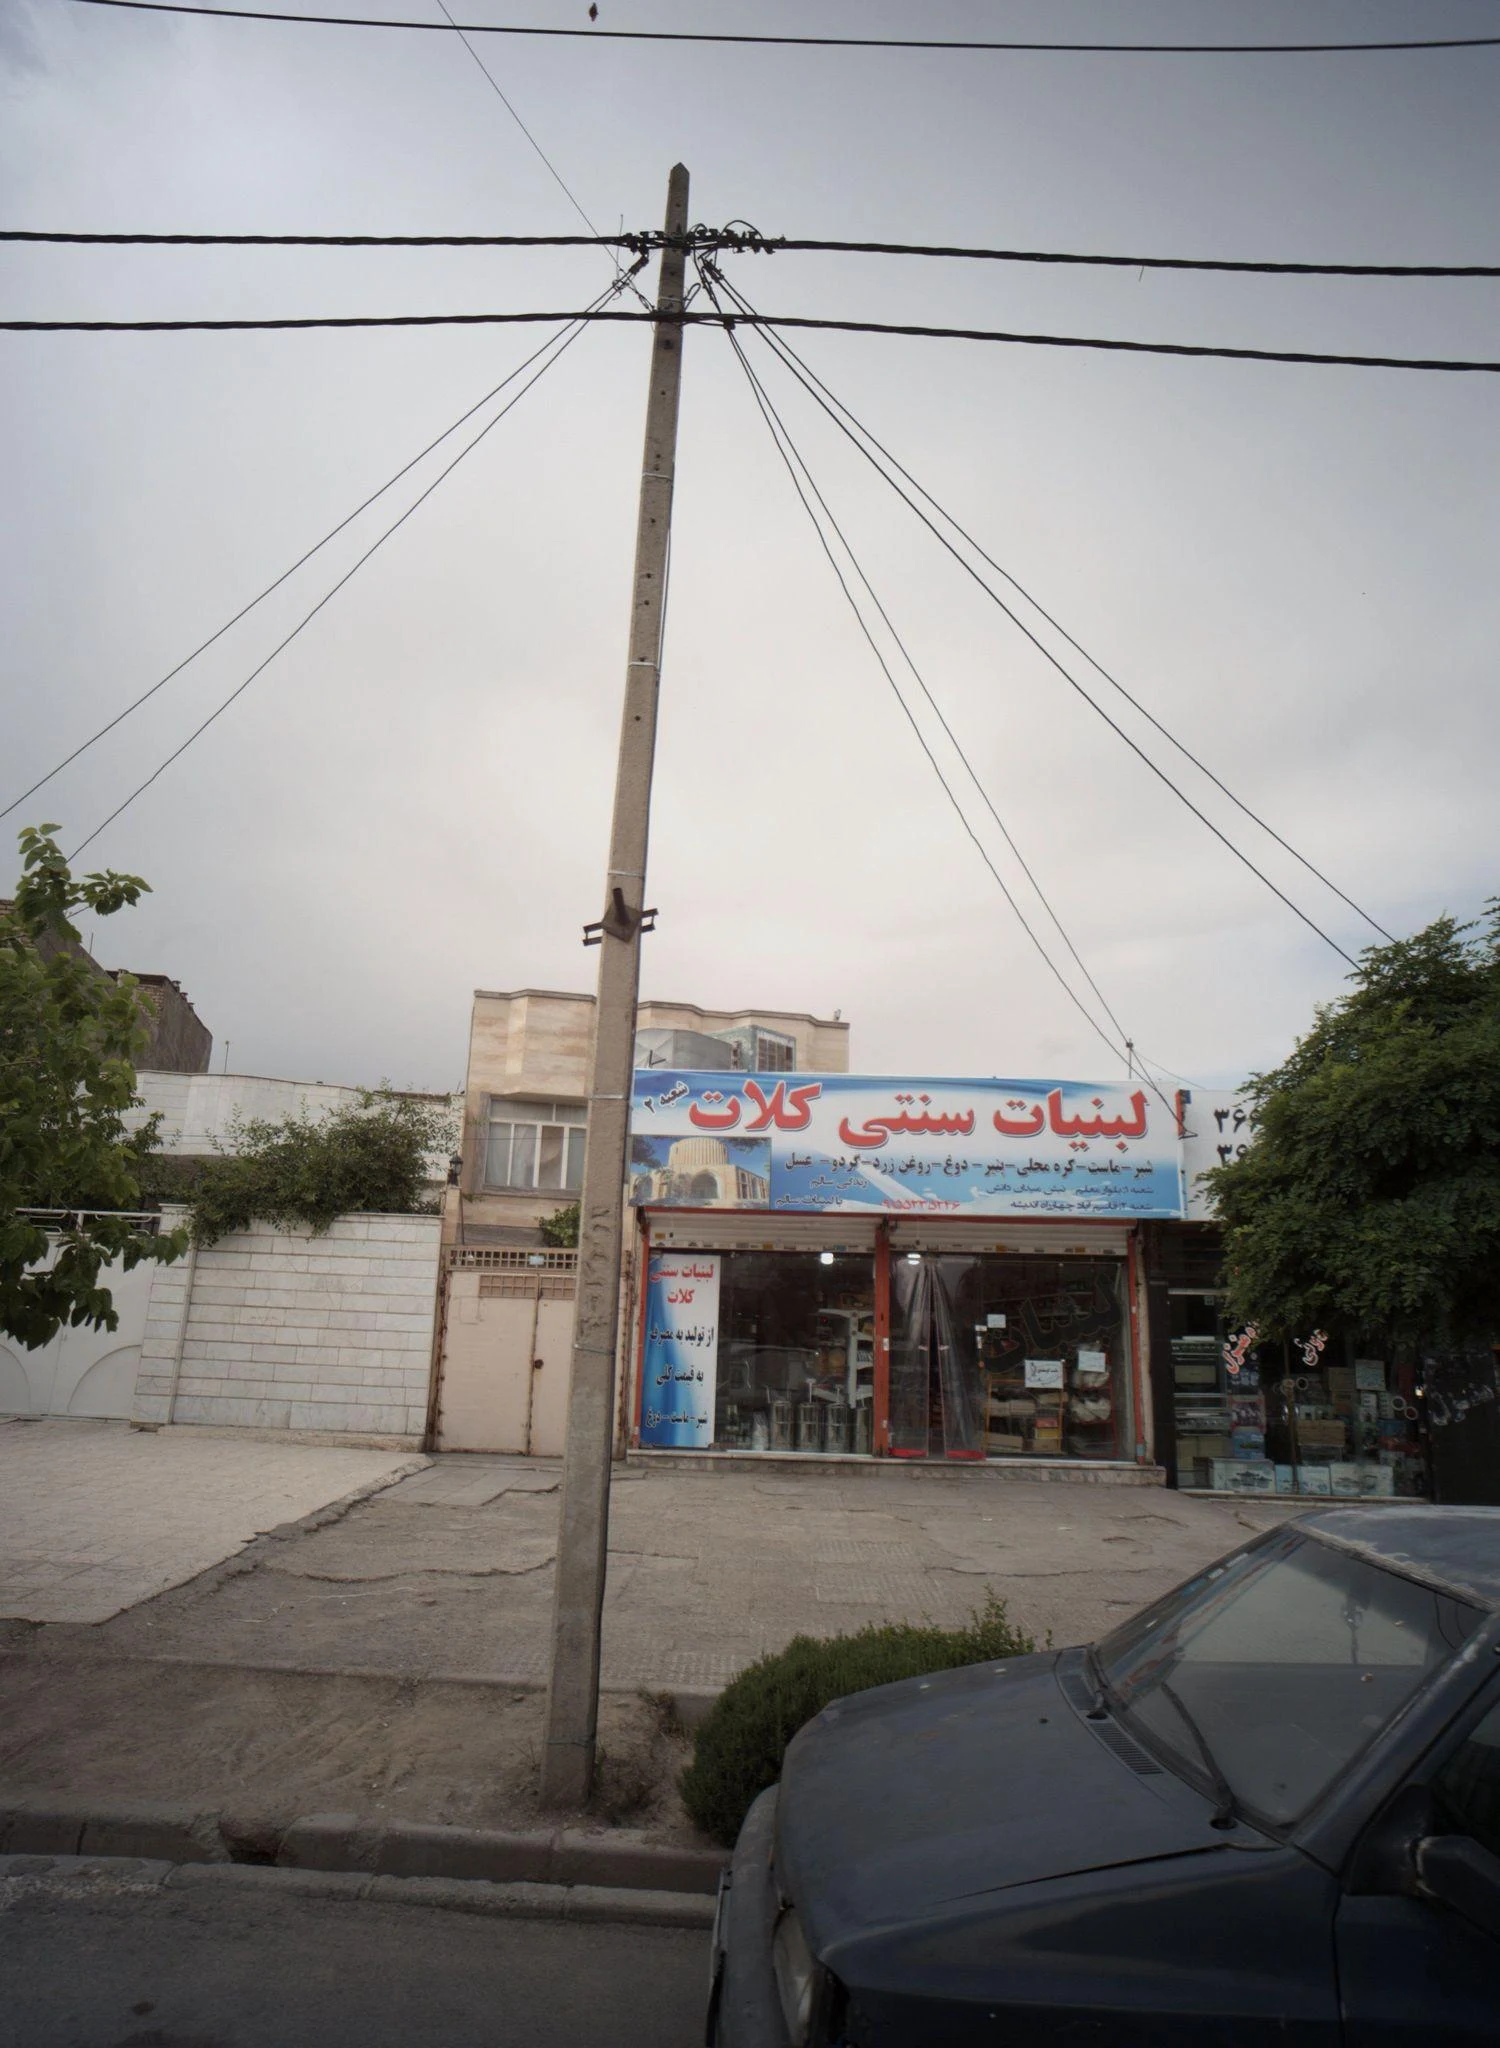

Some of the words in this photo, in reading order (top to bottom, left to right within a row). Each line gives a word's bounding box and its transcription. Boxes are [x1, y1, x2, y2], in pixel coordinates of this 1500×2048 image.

[658, 1080, 690, 1107] شعبه
[643, 1096, 656, 1115] ۲
[688, 1079, 823, 1132] کلات
[838, 1093, 976, 1150] سنتی
[993, 1087, 1149, 1152] لبنیات
[785, 1152, 812, 1170] عسل
[831, 1154, 861, 1173] گردو
[873, 1157, 895, 1174] زرد
[898, 1155, 931, 1175] روغن
[943, 1154, 968, 1176] دوغ
[1017, 1158, 1050, 1176] محلی
[1054, 1159, 1075, 1178] کره
[1088, 1159, 1120, 1174] ماست
[1134, 1160, 1153, 1178] شیر
[810, 1175, 834, 1188] سالم
[650, 1265, 678, 1282] سنتی
[682, 1264, 714, 1282] لبنیات
[667, 1288, 695, 1304] کلات
[676, 1330, 683, 1344] به
[685, 1326, 705, 1347] تولید
[706, 1326, 714, 1347] از
[696, 1369, 704, 1386] به
